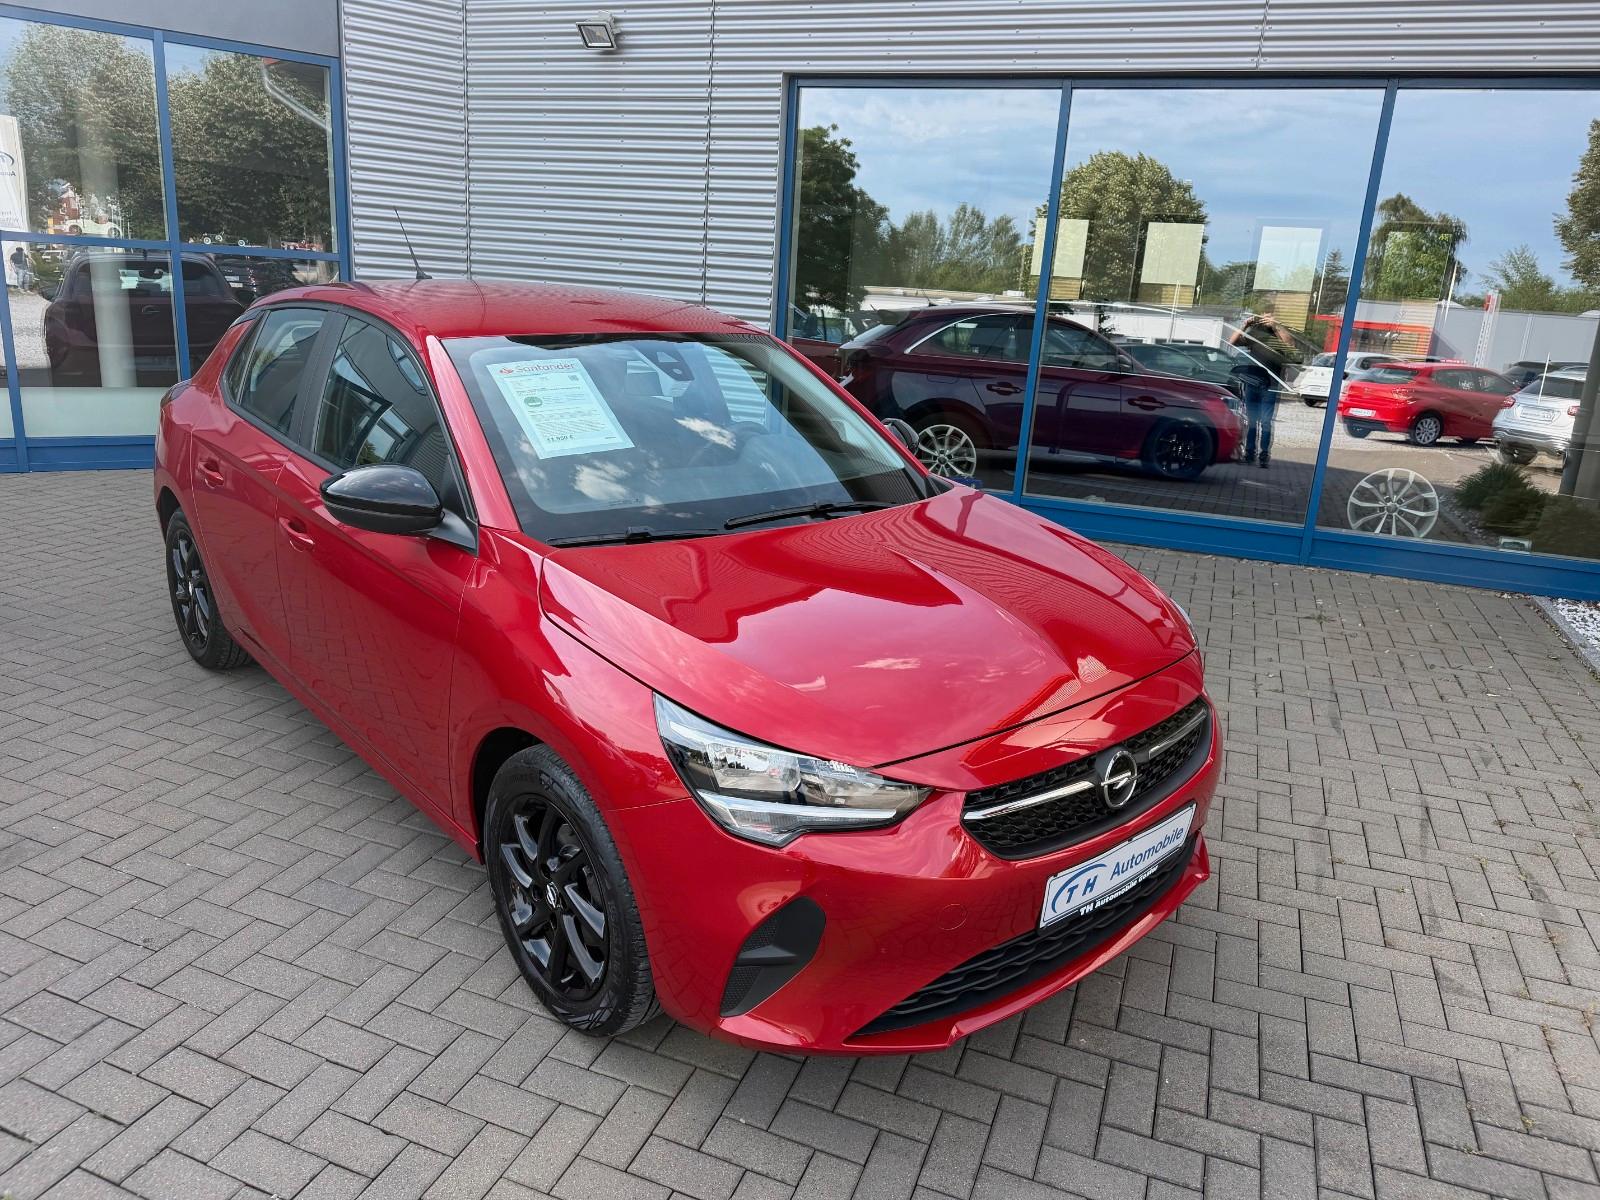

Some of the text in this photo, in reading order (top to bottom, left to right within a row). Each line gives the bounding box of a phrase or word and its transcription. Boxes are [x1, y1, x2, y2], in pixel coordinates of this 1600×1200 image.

[515, 362, 574, 373] Santander
[1110, 826, 1184, 880] Automobile
[1080, 902, 1094, 916] TH
[1095, 879, 1138, 909] Automobile
